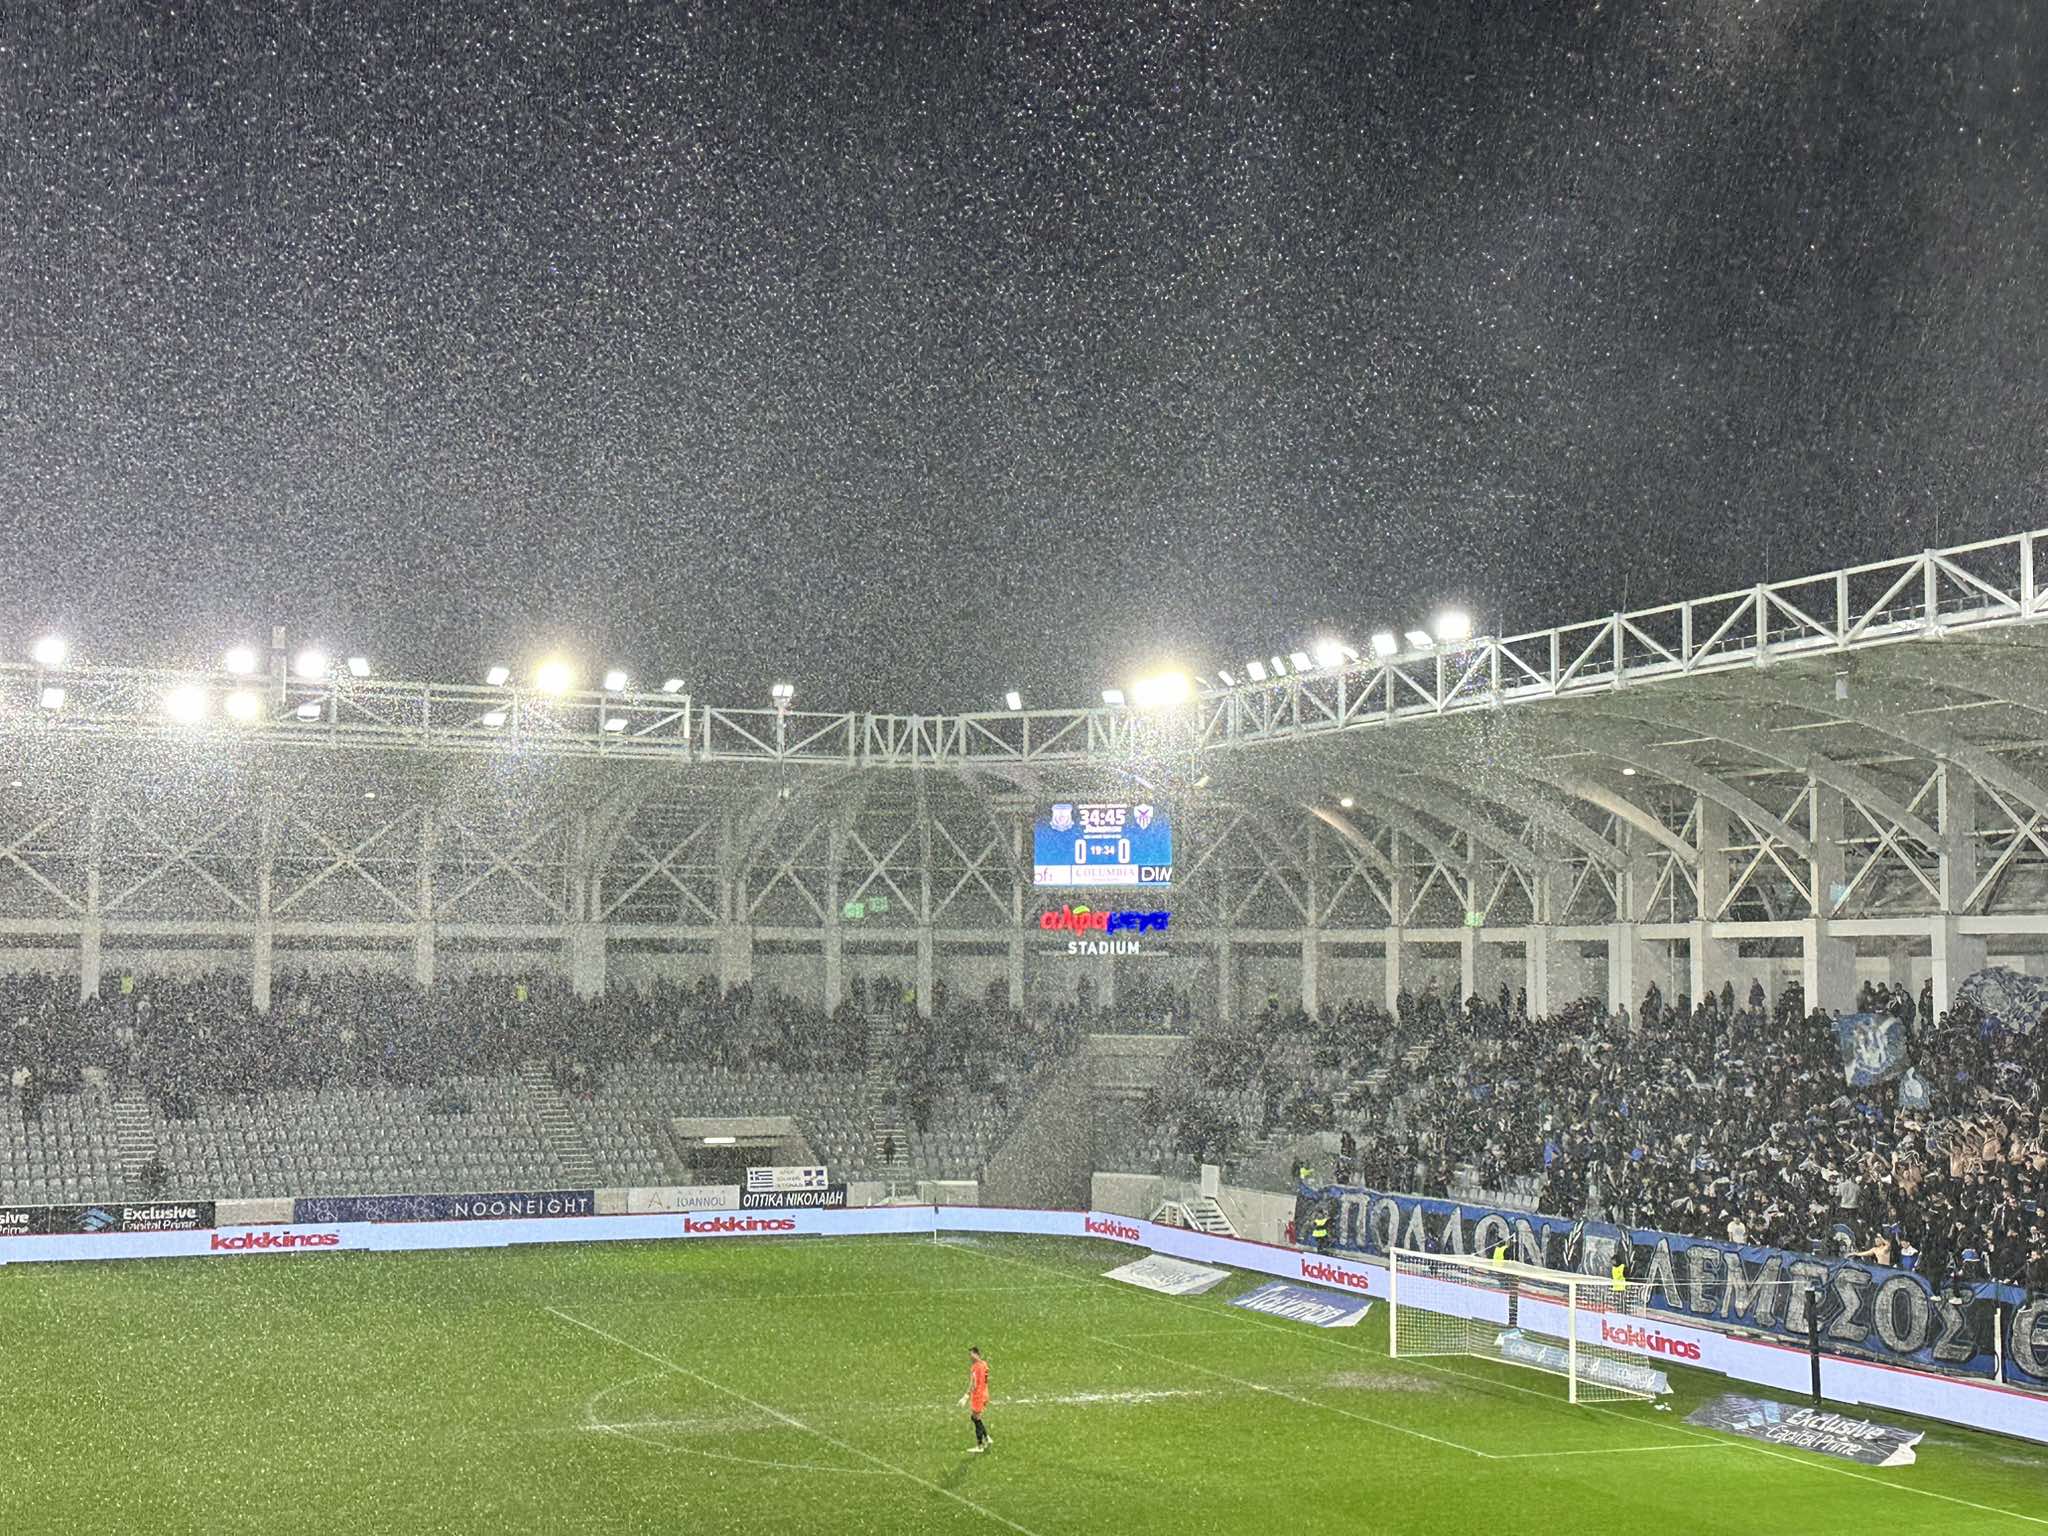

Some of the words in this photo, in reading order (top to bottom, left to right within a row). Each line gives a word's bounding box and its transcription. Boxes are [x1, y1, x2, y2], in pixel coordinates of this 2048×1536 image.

[1079, 809, 1127, 826] 34:45
[1075, 838, 1087, 864] 0
[1118, 838, 1130, 864] 0
[1068, 941, 1140, 955] STADIUM
[454, 1198, 588, 1217] NOONEIGHT
[677, 1196, 726, 1208] IOANNOU
[743, 1193, 783, 1207] ΟΠΤΙΚΑ
[786, 1191, 844, 1206] ΝΙΚΟΛΑΙΔΗ
[123, 1206, 197, 1220] Exclusive
[684, 1216, 796, 1233] kokkinos
[1085, 1217, 1140, 1241] kokkinos
[211, 1231, 340, 1250] kokkinos
[1301, 1258, 1369, 1290] kokkinos
[1602, 1319, 1701, 1360] kokkinos
[1786, 1408, 1887, 1440] Exclusive
[1766, 1425, 1820, 1448] Capital
[1816, 1435, 1863, 1456] Prime
